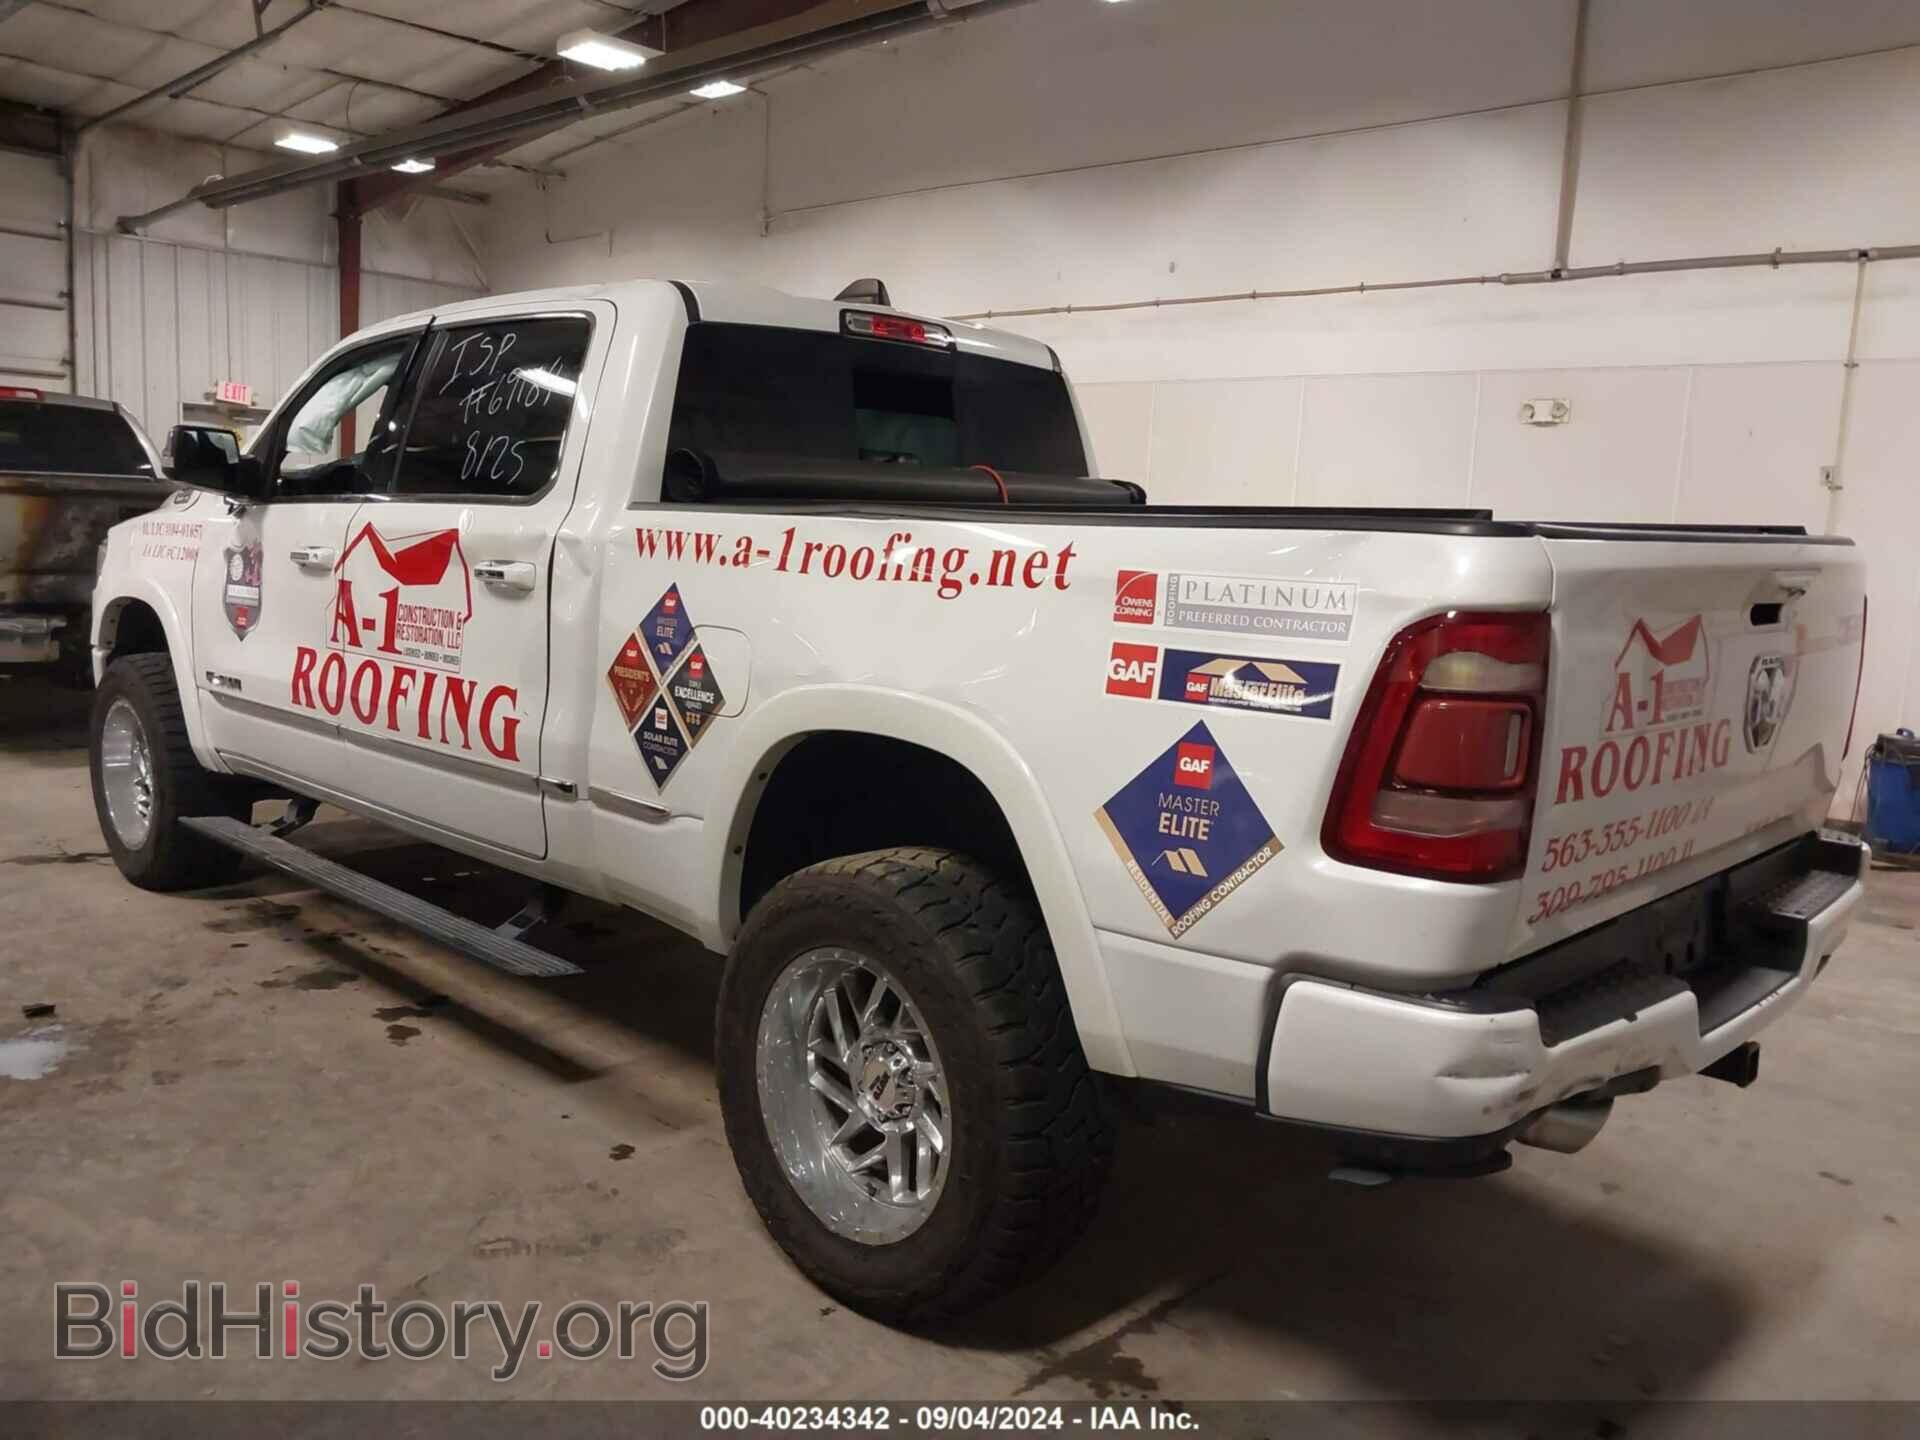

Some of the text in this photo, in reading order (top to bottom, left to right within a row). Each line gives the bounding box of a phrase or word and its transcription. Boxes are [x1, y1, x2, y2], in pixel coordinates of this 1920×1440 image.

[223, 382, 249, 403] EXIT
[634, 526, 1077, 599] www.a-1roofing.net
[1121, 595, 1154, 608] OWENS
[1166, 574, 1179, 626] ROOFING
[1185, 580, 1347, 610] PLATINUM
[330, 579, 402, 655] A-1
[398, 604, 454, 629] CONSTRUCTION
[1114, 606, 1153, 618] CORNING
[1179, 609, 1347, 634] PREFERRED CONTRACTOR
[447, 630, 461, 650] LLC
[1108, 658, 1157, 684] GAF
[674, 685, 715, 704] EXCELLENCE
[1186, 681, 1209, 694] GAF
[1605, 668, 1664, 732] A-1
[291, 646, 520, 762] ROOFING
[1180, 756, 1210, 774] GAF
[1554, 719, 1731, 805] ROOFING
[1158, 792, 1220, 816] MASTER
[1158, 812, 1211, 841] ELITE
[1126, 860, 1172, 924] RESIDENTIAL
[1171, 846, 1273, 937] ROOFING CONTRACTOR
